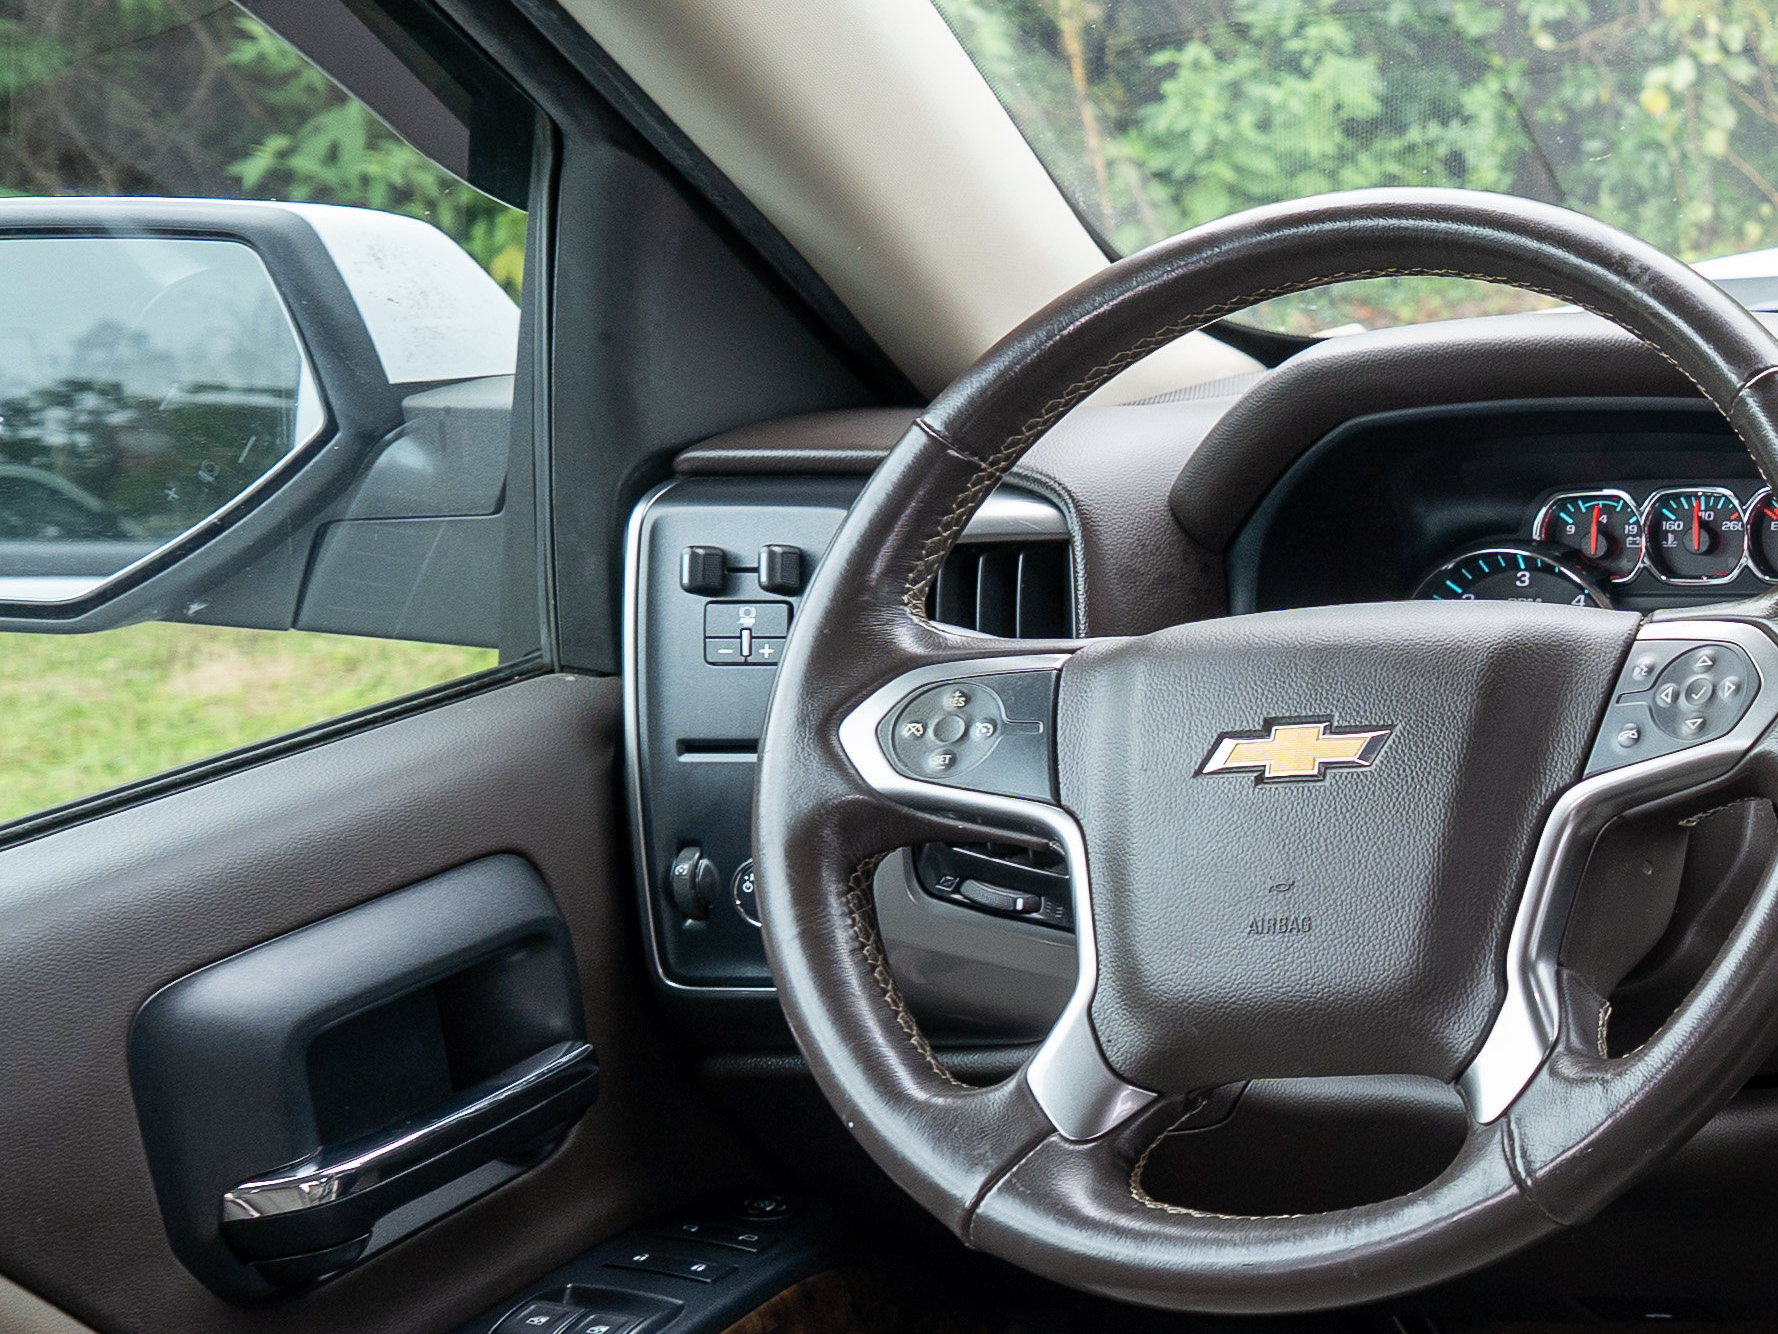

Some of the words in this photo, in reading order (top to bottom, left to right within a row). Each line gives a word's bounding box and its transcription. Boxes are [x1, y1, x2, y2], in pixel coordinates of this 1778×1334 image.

[1566, 524, 1576, 535] 9
[1624, 524, 1638, 535] 19
[1662, 520, 1683, 531] 160
[1770, 521, 1778, 531] E
[1515, 571, 1530, 587] 3
[1571, 594, 1585, 607] 4
[932, 754, 953, 765] SET
[1247, 915, 1312, 935] AIRBAG
